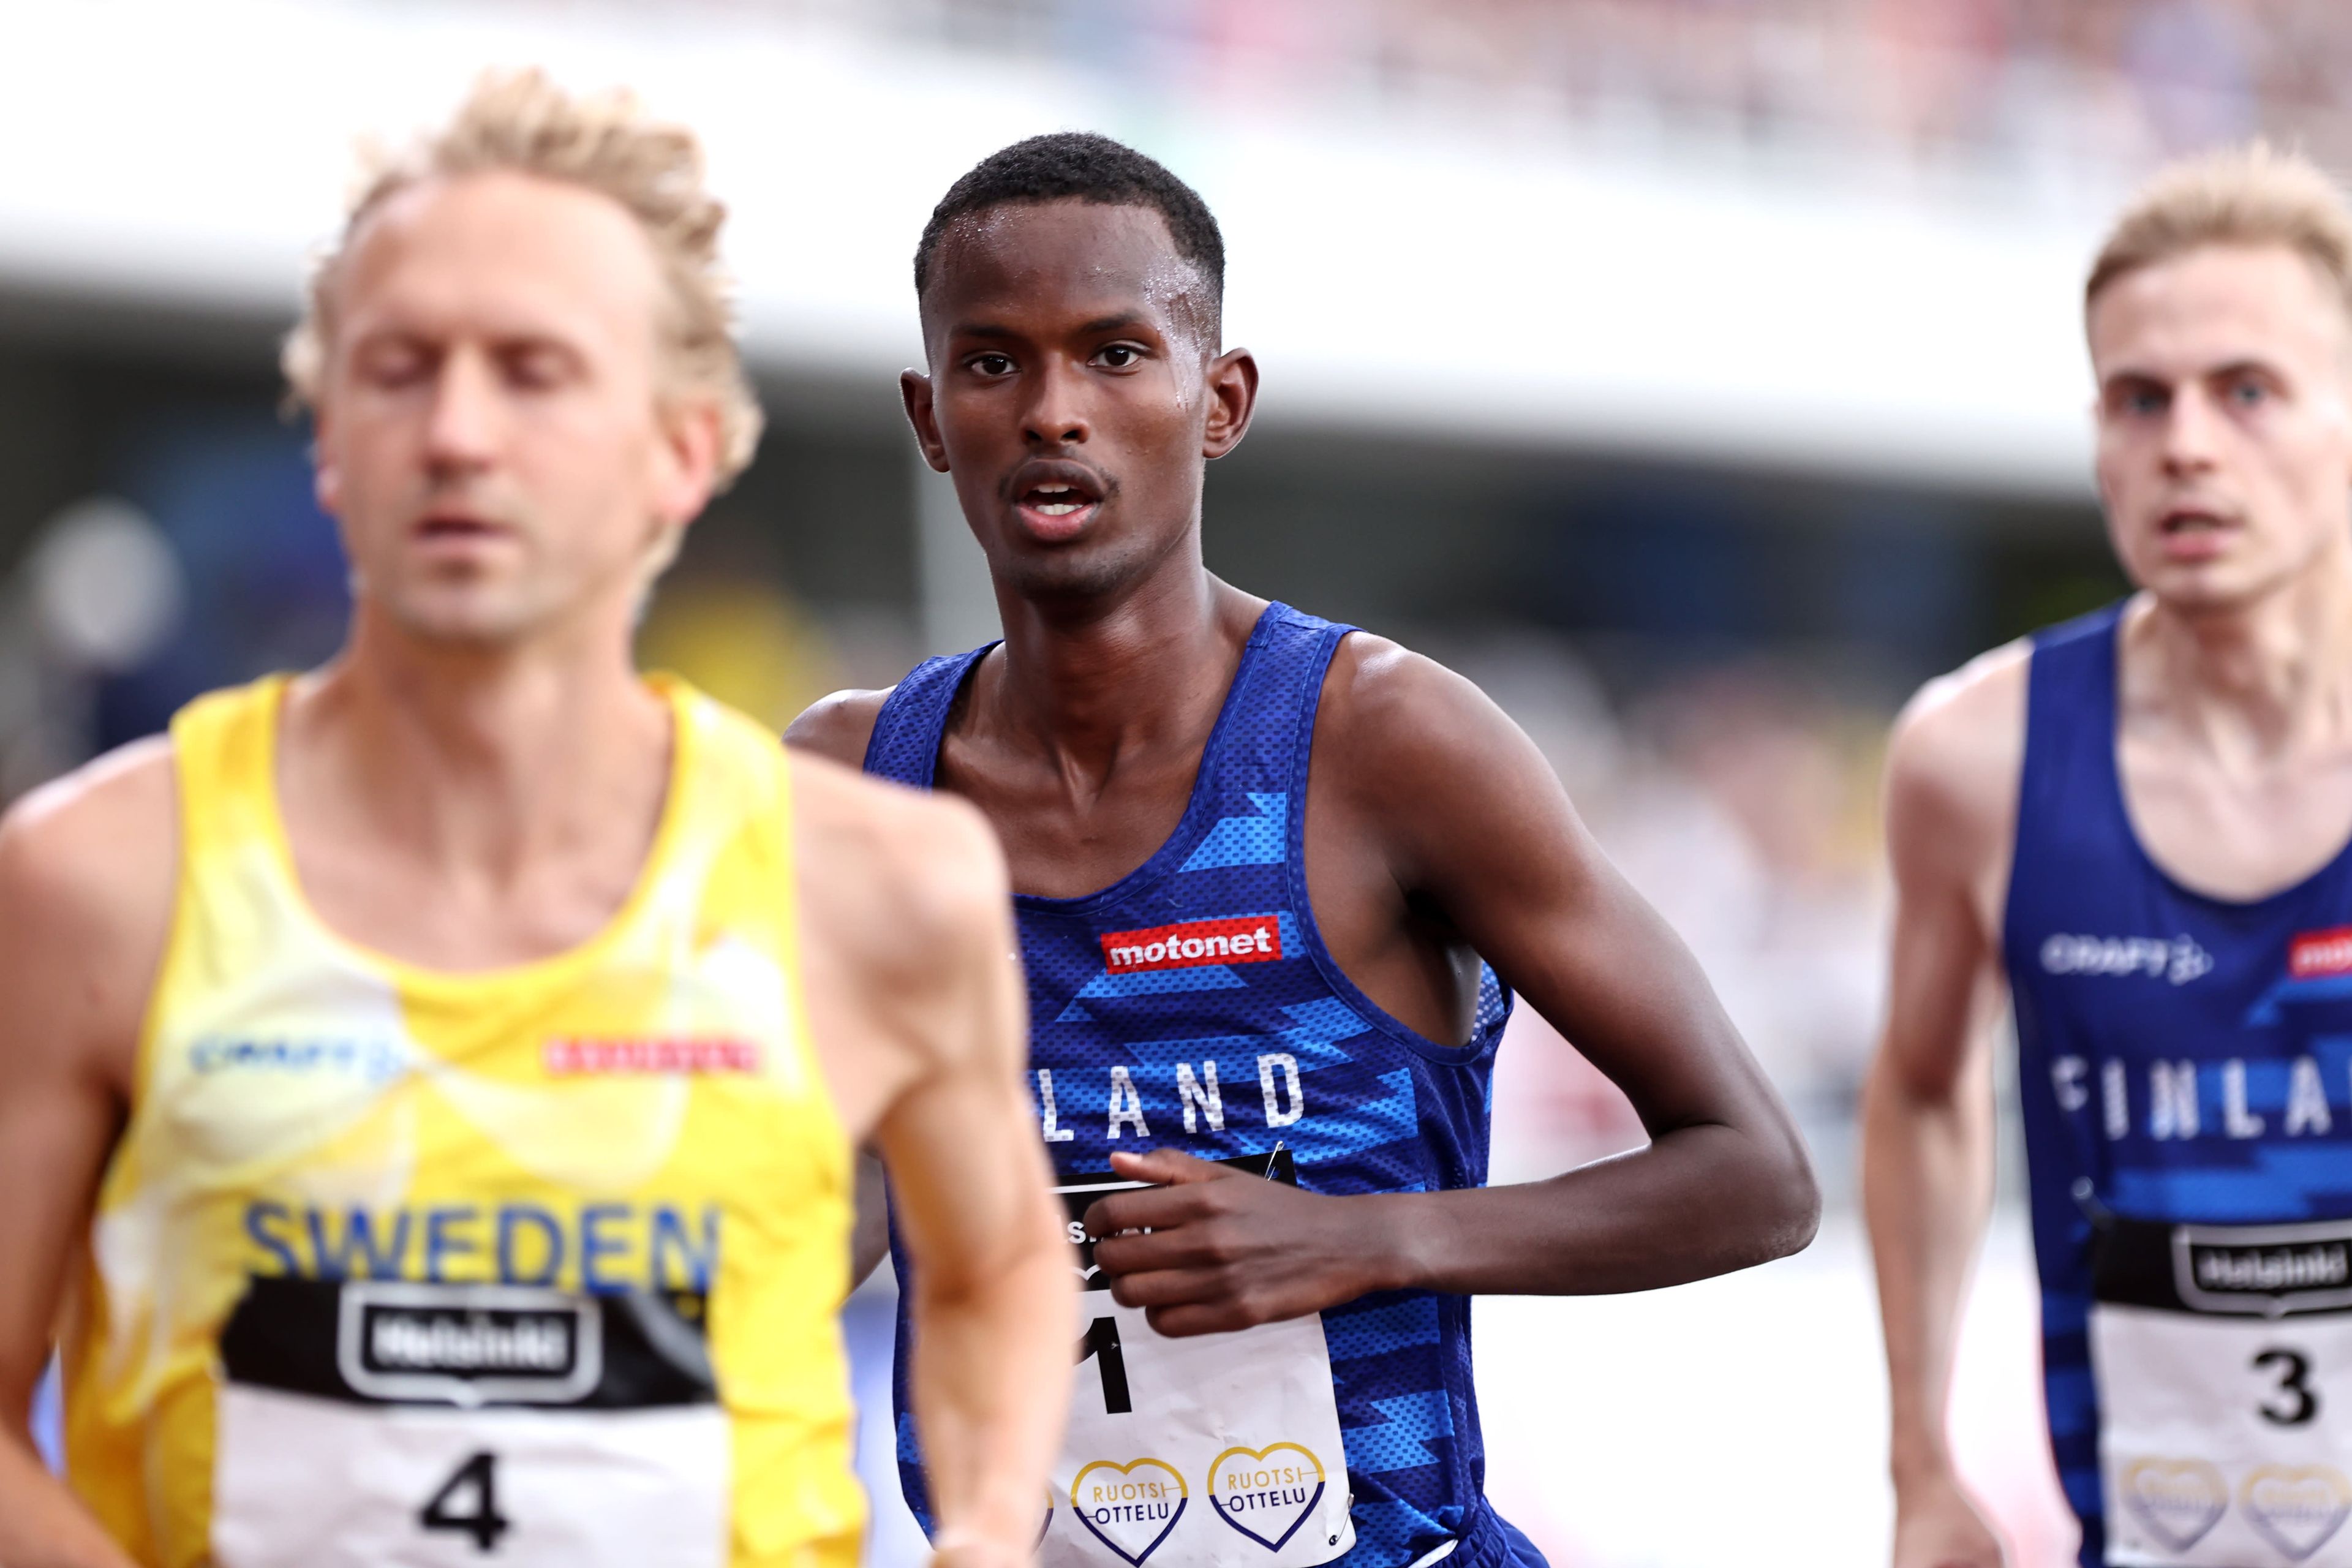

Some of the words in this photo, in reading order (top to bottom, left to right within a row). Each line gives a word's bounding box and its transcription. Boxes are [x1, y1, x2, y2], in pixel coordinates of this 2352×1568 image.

[1109, 925, 1272, 967] motonet
[2050, 1054, 2352, 1141] FINLA
[243, 1202, 722, 1296] SWEDEN
[1073, 1316, 1133, 1414] 1
[2252, 1346, 2320, 1428] 3
[420, 1450, 510, 1551] 4
[1093, 1482, 1166, 1502] RUOTSI
[1227, 1466, 1303, 1490] RUOTSI
[1229, 1487, 1306, 1512] OTTELU
[1095, 1502, 1169, 1525] OTTELU
